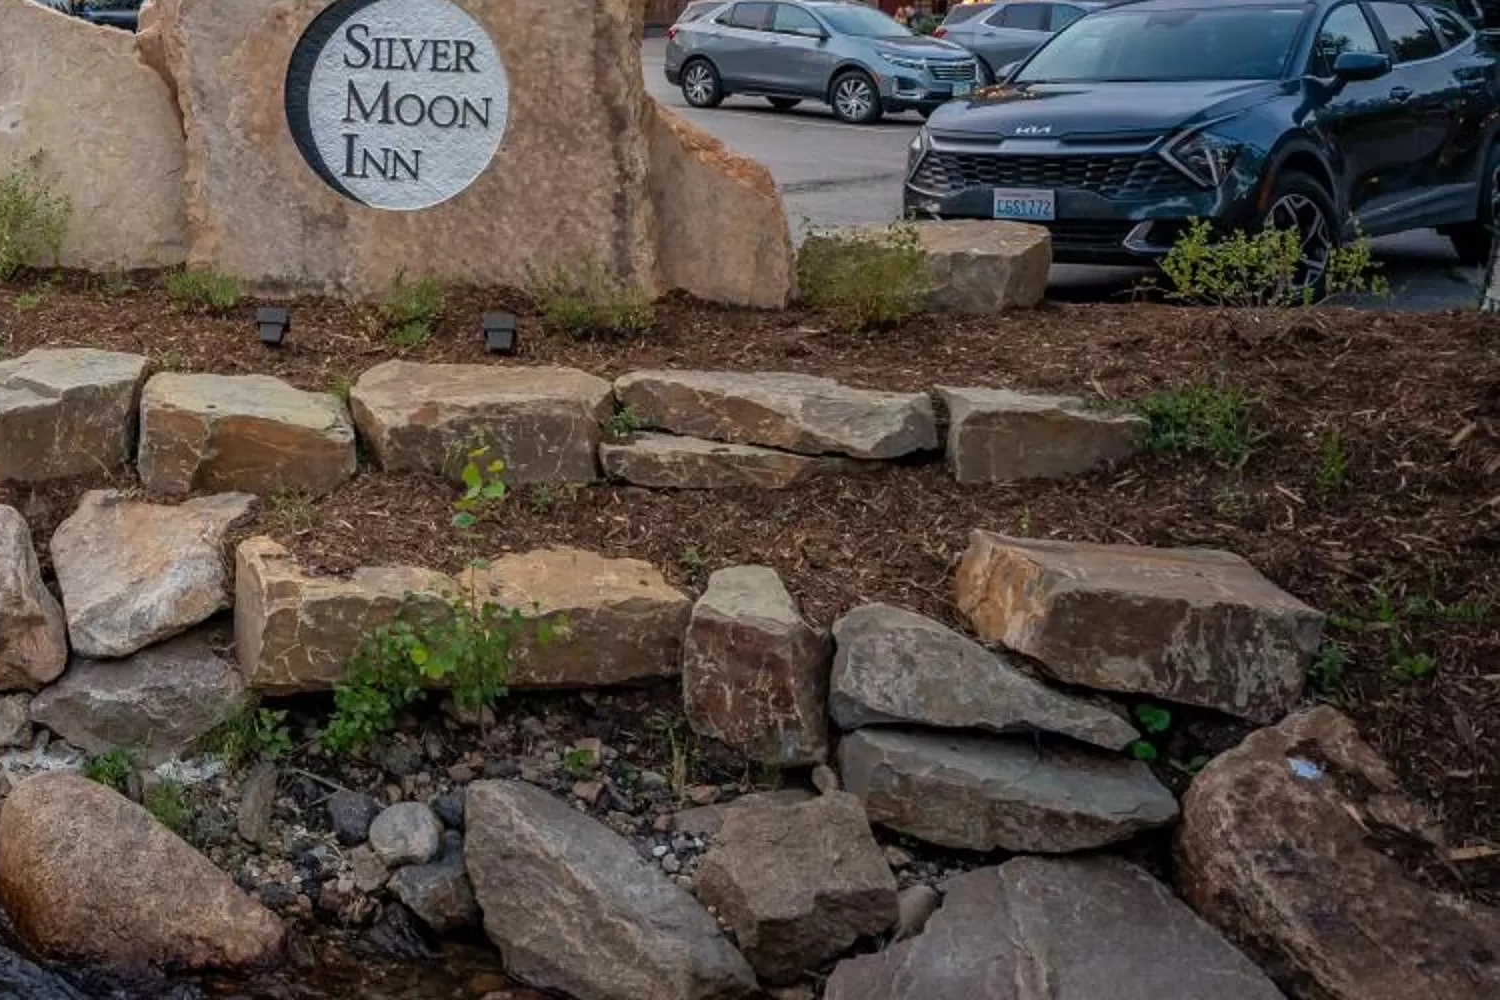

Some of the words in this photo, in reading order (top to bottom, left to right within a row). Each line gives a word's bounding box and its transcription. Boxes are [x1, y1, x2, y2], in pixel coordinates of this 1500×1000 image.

[343, 23, 480, 73] SILVER
[341, 79, 493, 129] MOON
[341, 133, 422, 181] INN
